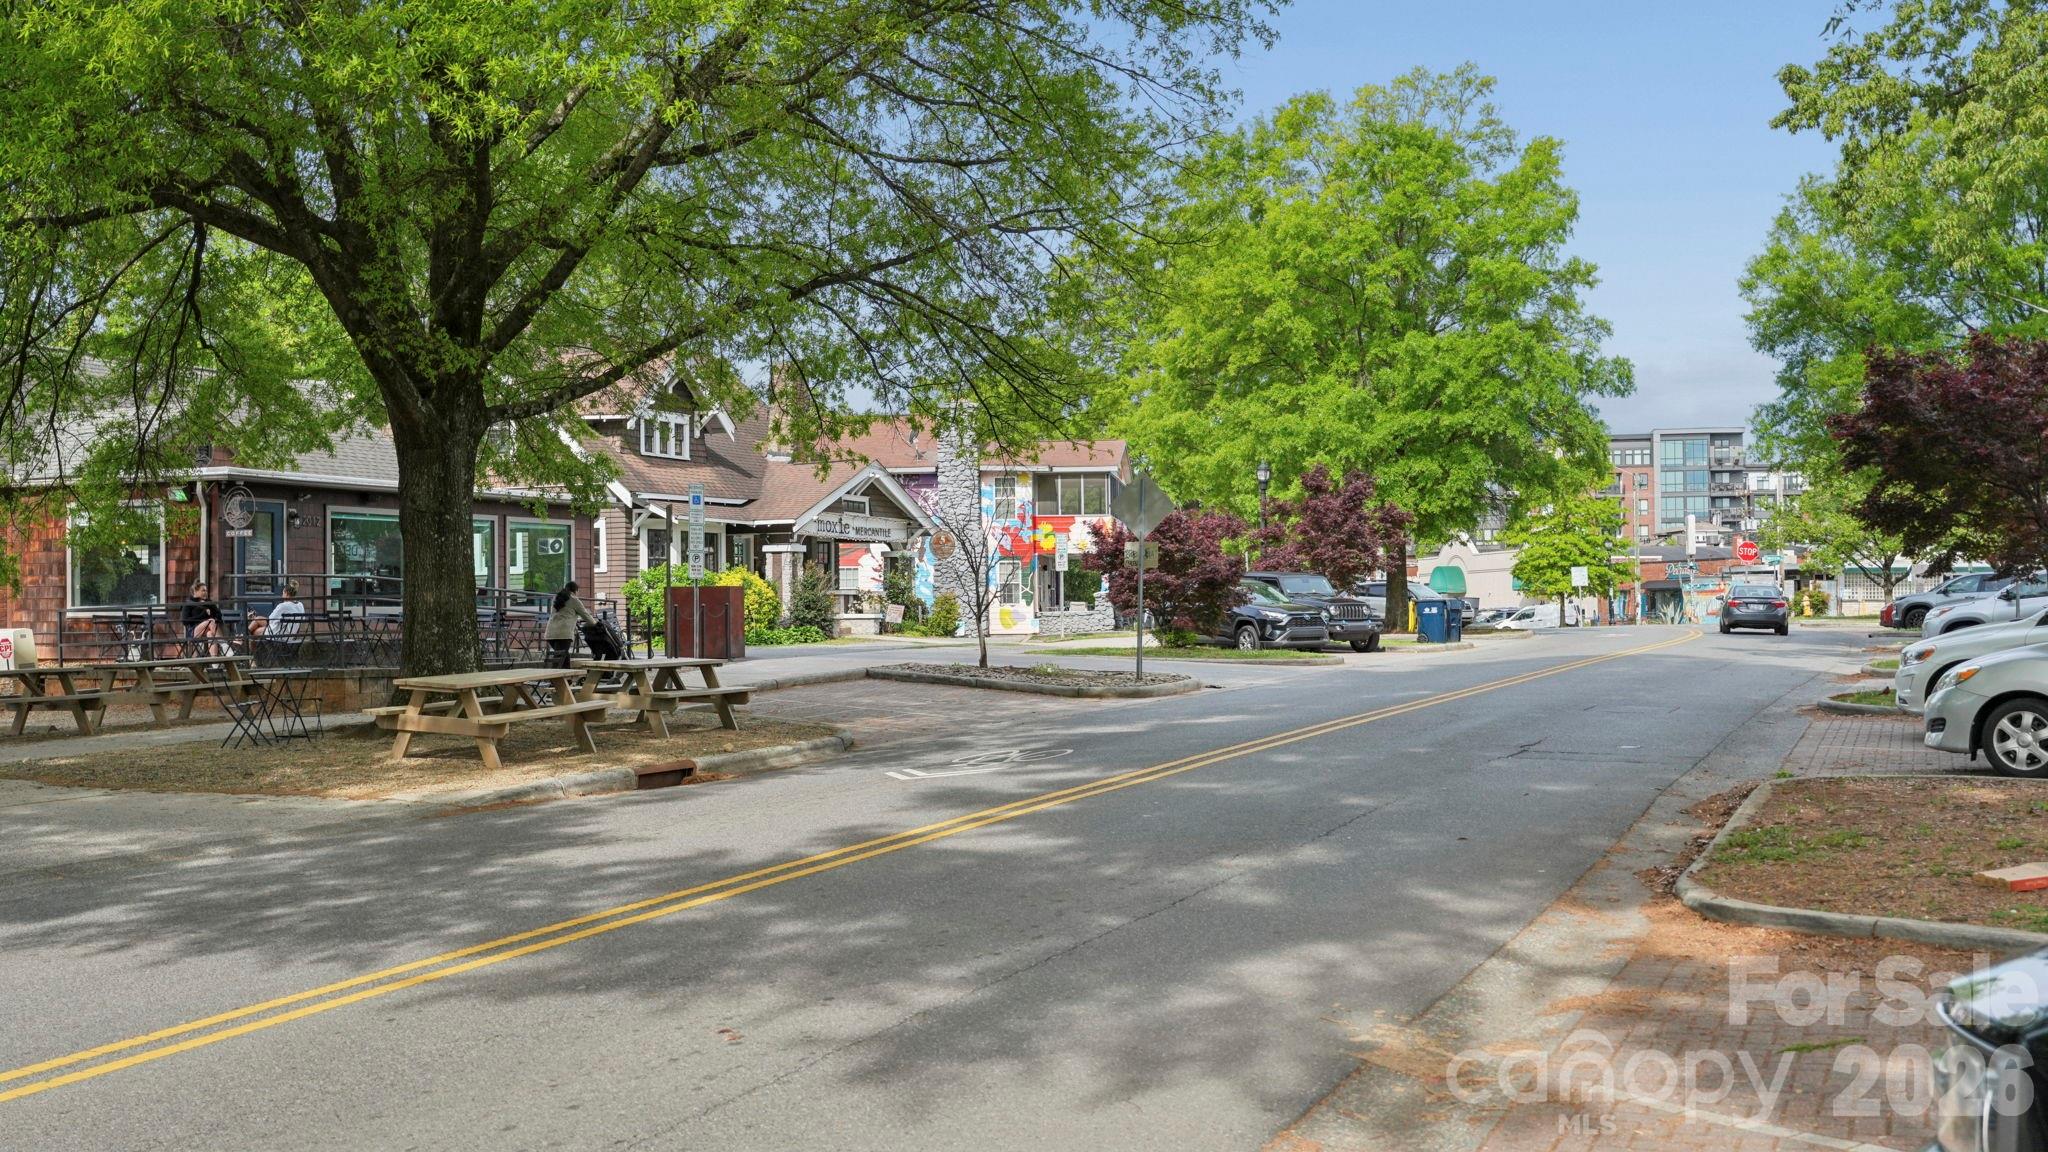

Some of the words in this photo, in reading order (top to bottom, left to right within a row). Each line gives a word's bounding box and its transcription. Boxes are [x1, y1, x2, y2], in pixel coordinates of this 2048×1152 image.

[816, 518, 850, 536] moxie
[855, 526, 891, 538] MERCANTILE
[1739, 547, 1758, 556] STOP
